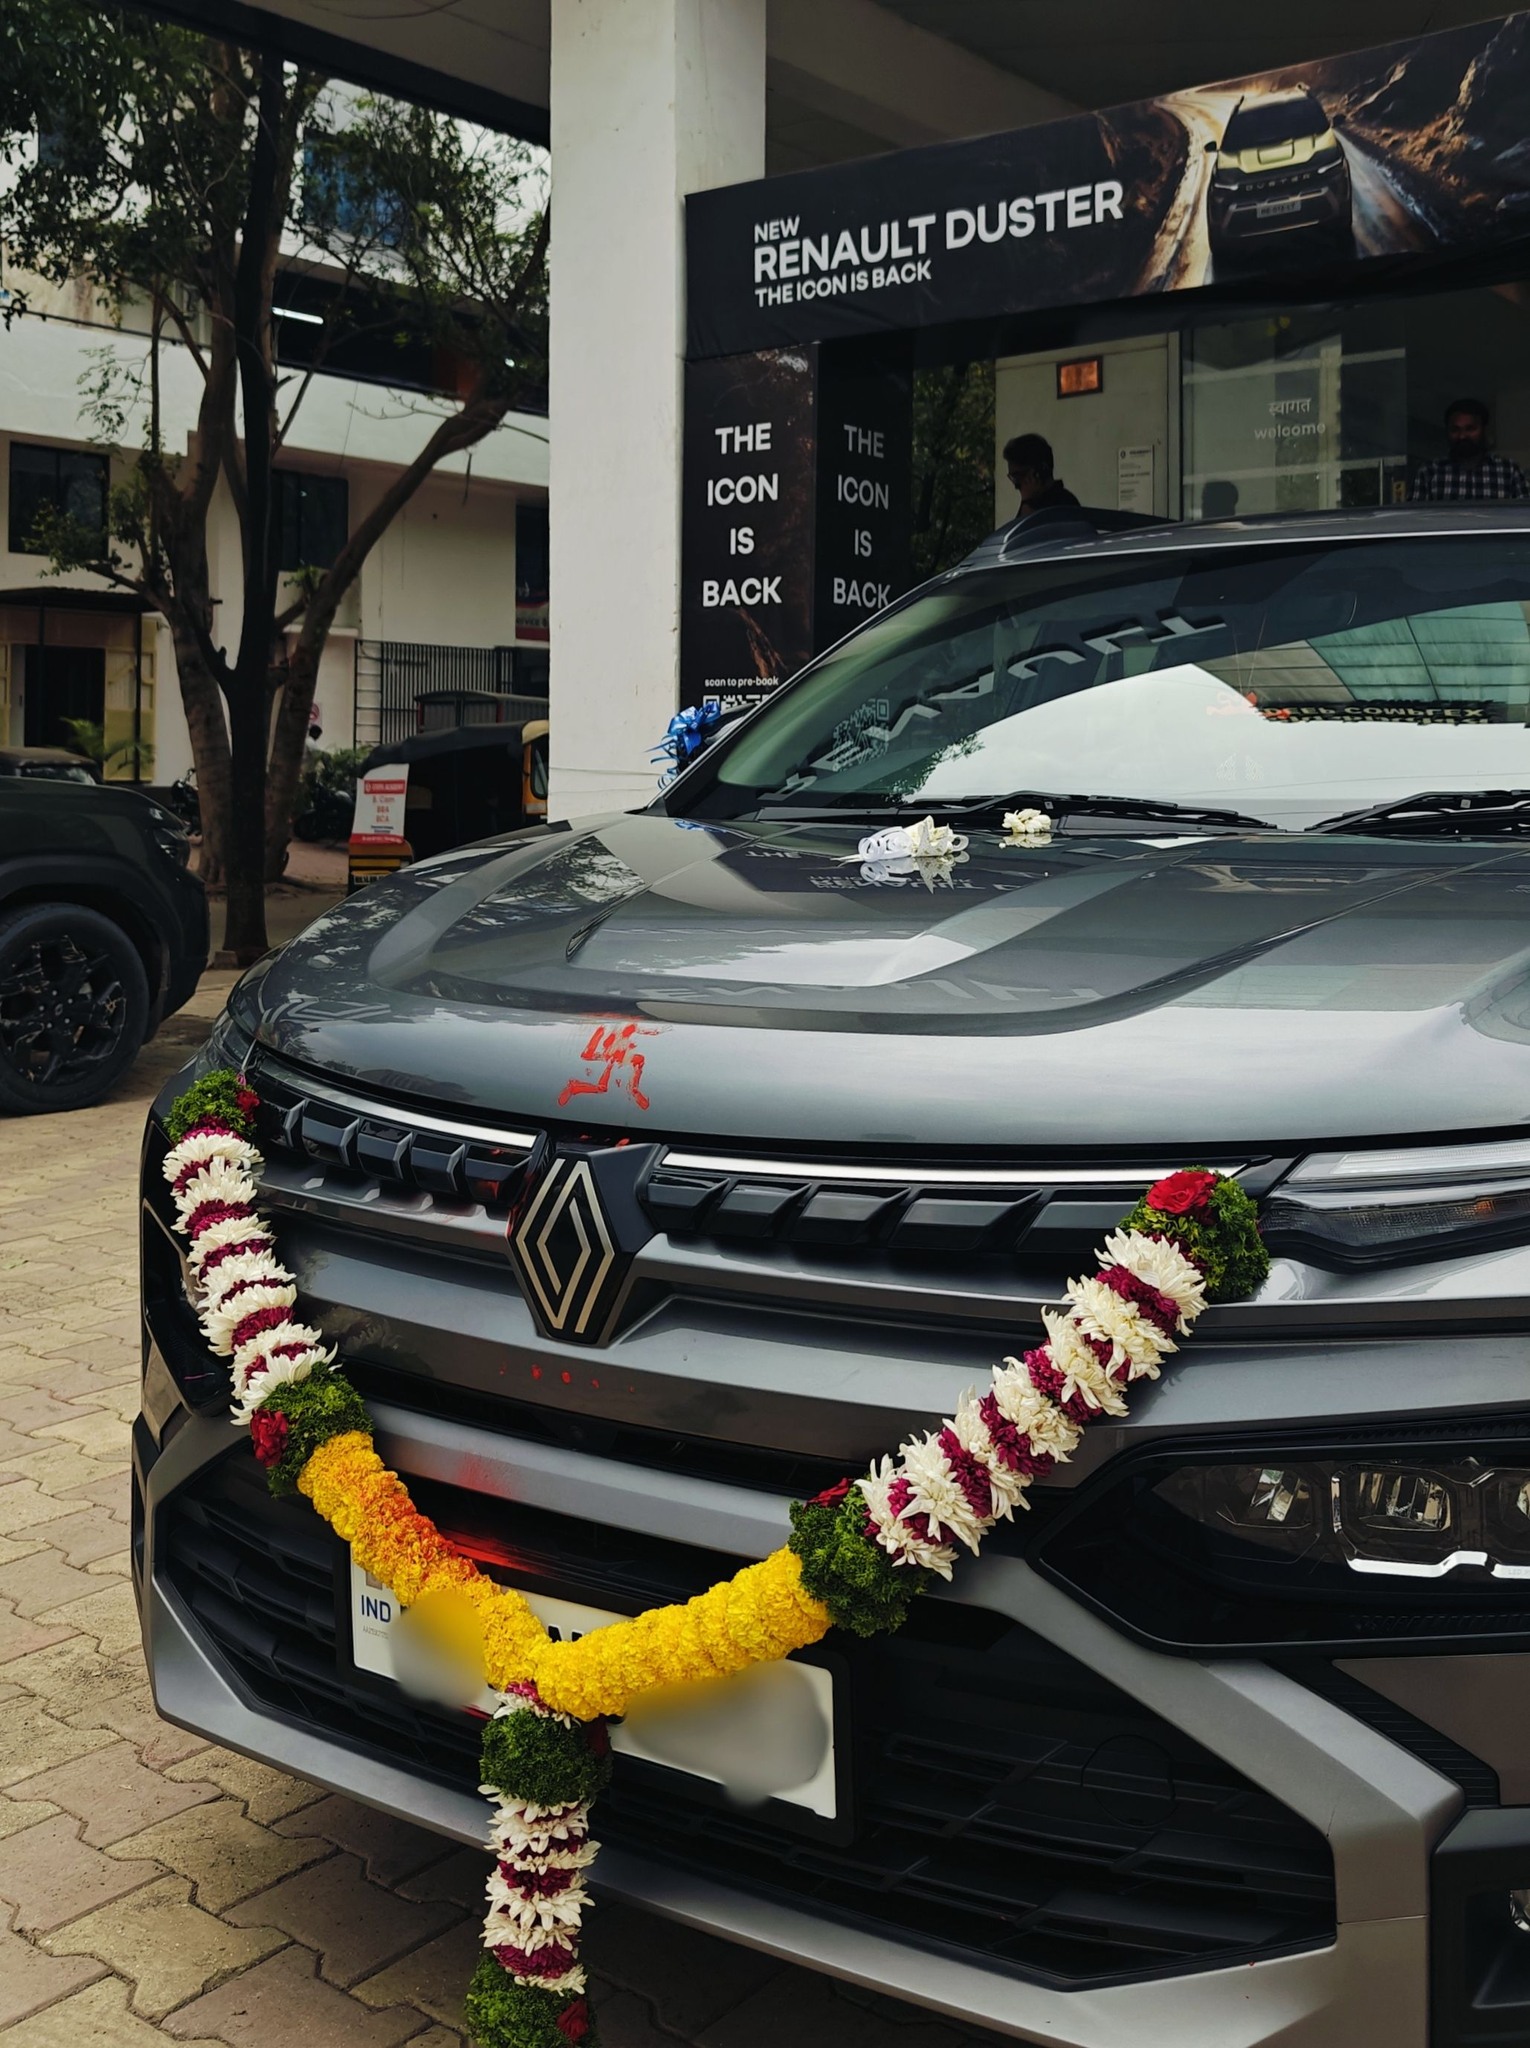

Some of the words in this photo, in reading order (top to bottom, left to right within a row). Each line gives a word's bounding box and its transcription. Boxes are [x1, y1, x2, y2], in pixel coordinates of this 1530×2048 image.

[753, 215, 801, 244] NEW
[753, 213, 936, 284] RENAULT
[945, 179, 1125, 250] DUSTER
[754, 286, 794, 308] THE
[796, 273, 848, 302] ICON
[850, 271, 869, 293] IS
[872, 259, 932, 289] BACK
[1266, 397, 1312, 417] स्वागत
[714, 422, 772, 455] THE
[843, 424, 885, 459] THE
[1253, 422, 1326, 440] welcome
[707, 472, 779, 507] ICON
[837, 474, 890, 511] ICON
[729, 526, 756, 556] IS
[854, 528, 873, 558] IS
[702, 575, 783, 608] BACK
[833, 576, 891, 610] BACK
[704, 677, 727, 688] scan
[727, 677, 737, 687] to
[737, 675, 780, 689] pre-book
[361, 1594, 392, 1624] IND
